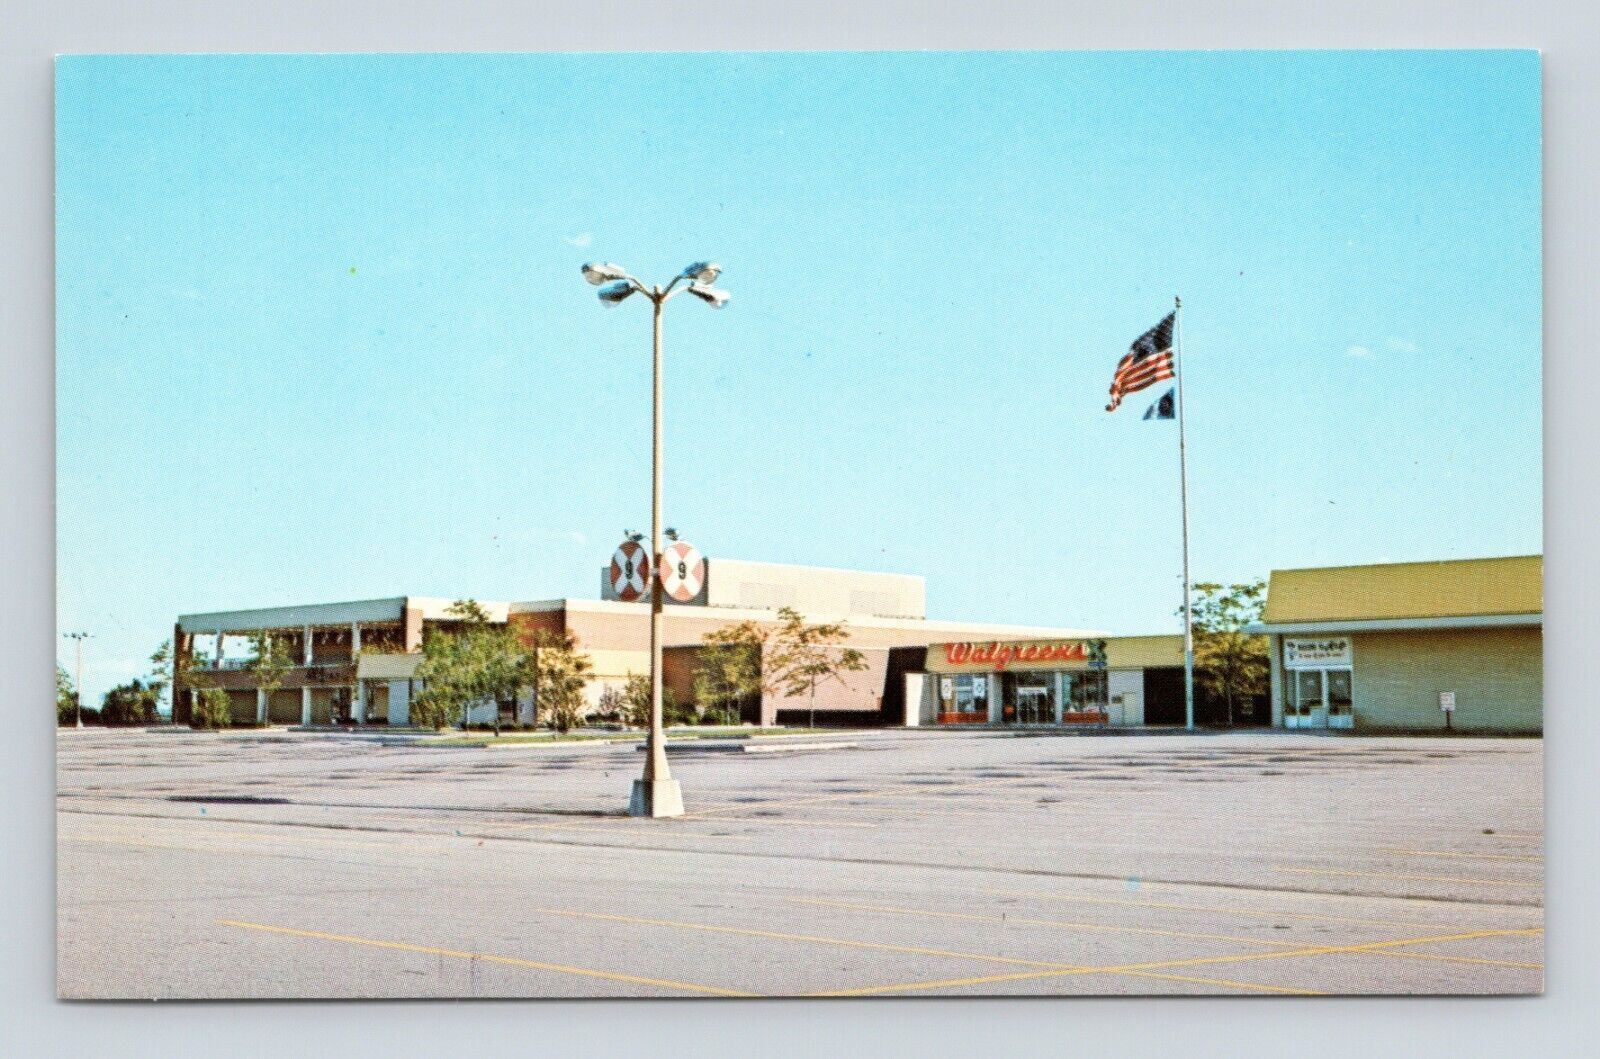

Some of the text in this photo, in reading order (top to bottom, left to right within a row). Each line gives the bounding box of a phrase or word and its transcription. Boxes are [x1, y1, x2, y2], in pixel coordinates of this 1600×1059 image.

[625, 560, 634, 580] 9
[678, 560, 687, 580] 9
[944, 642, 1088, 670] Walgreens
